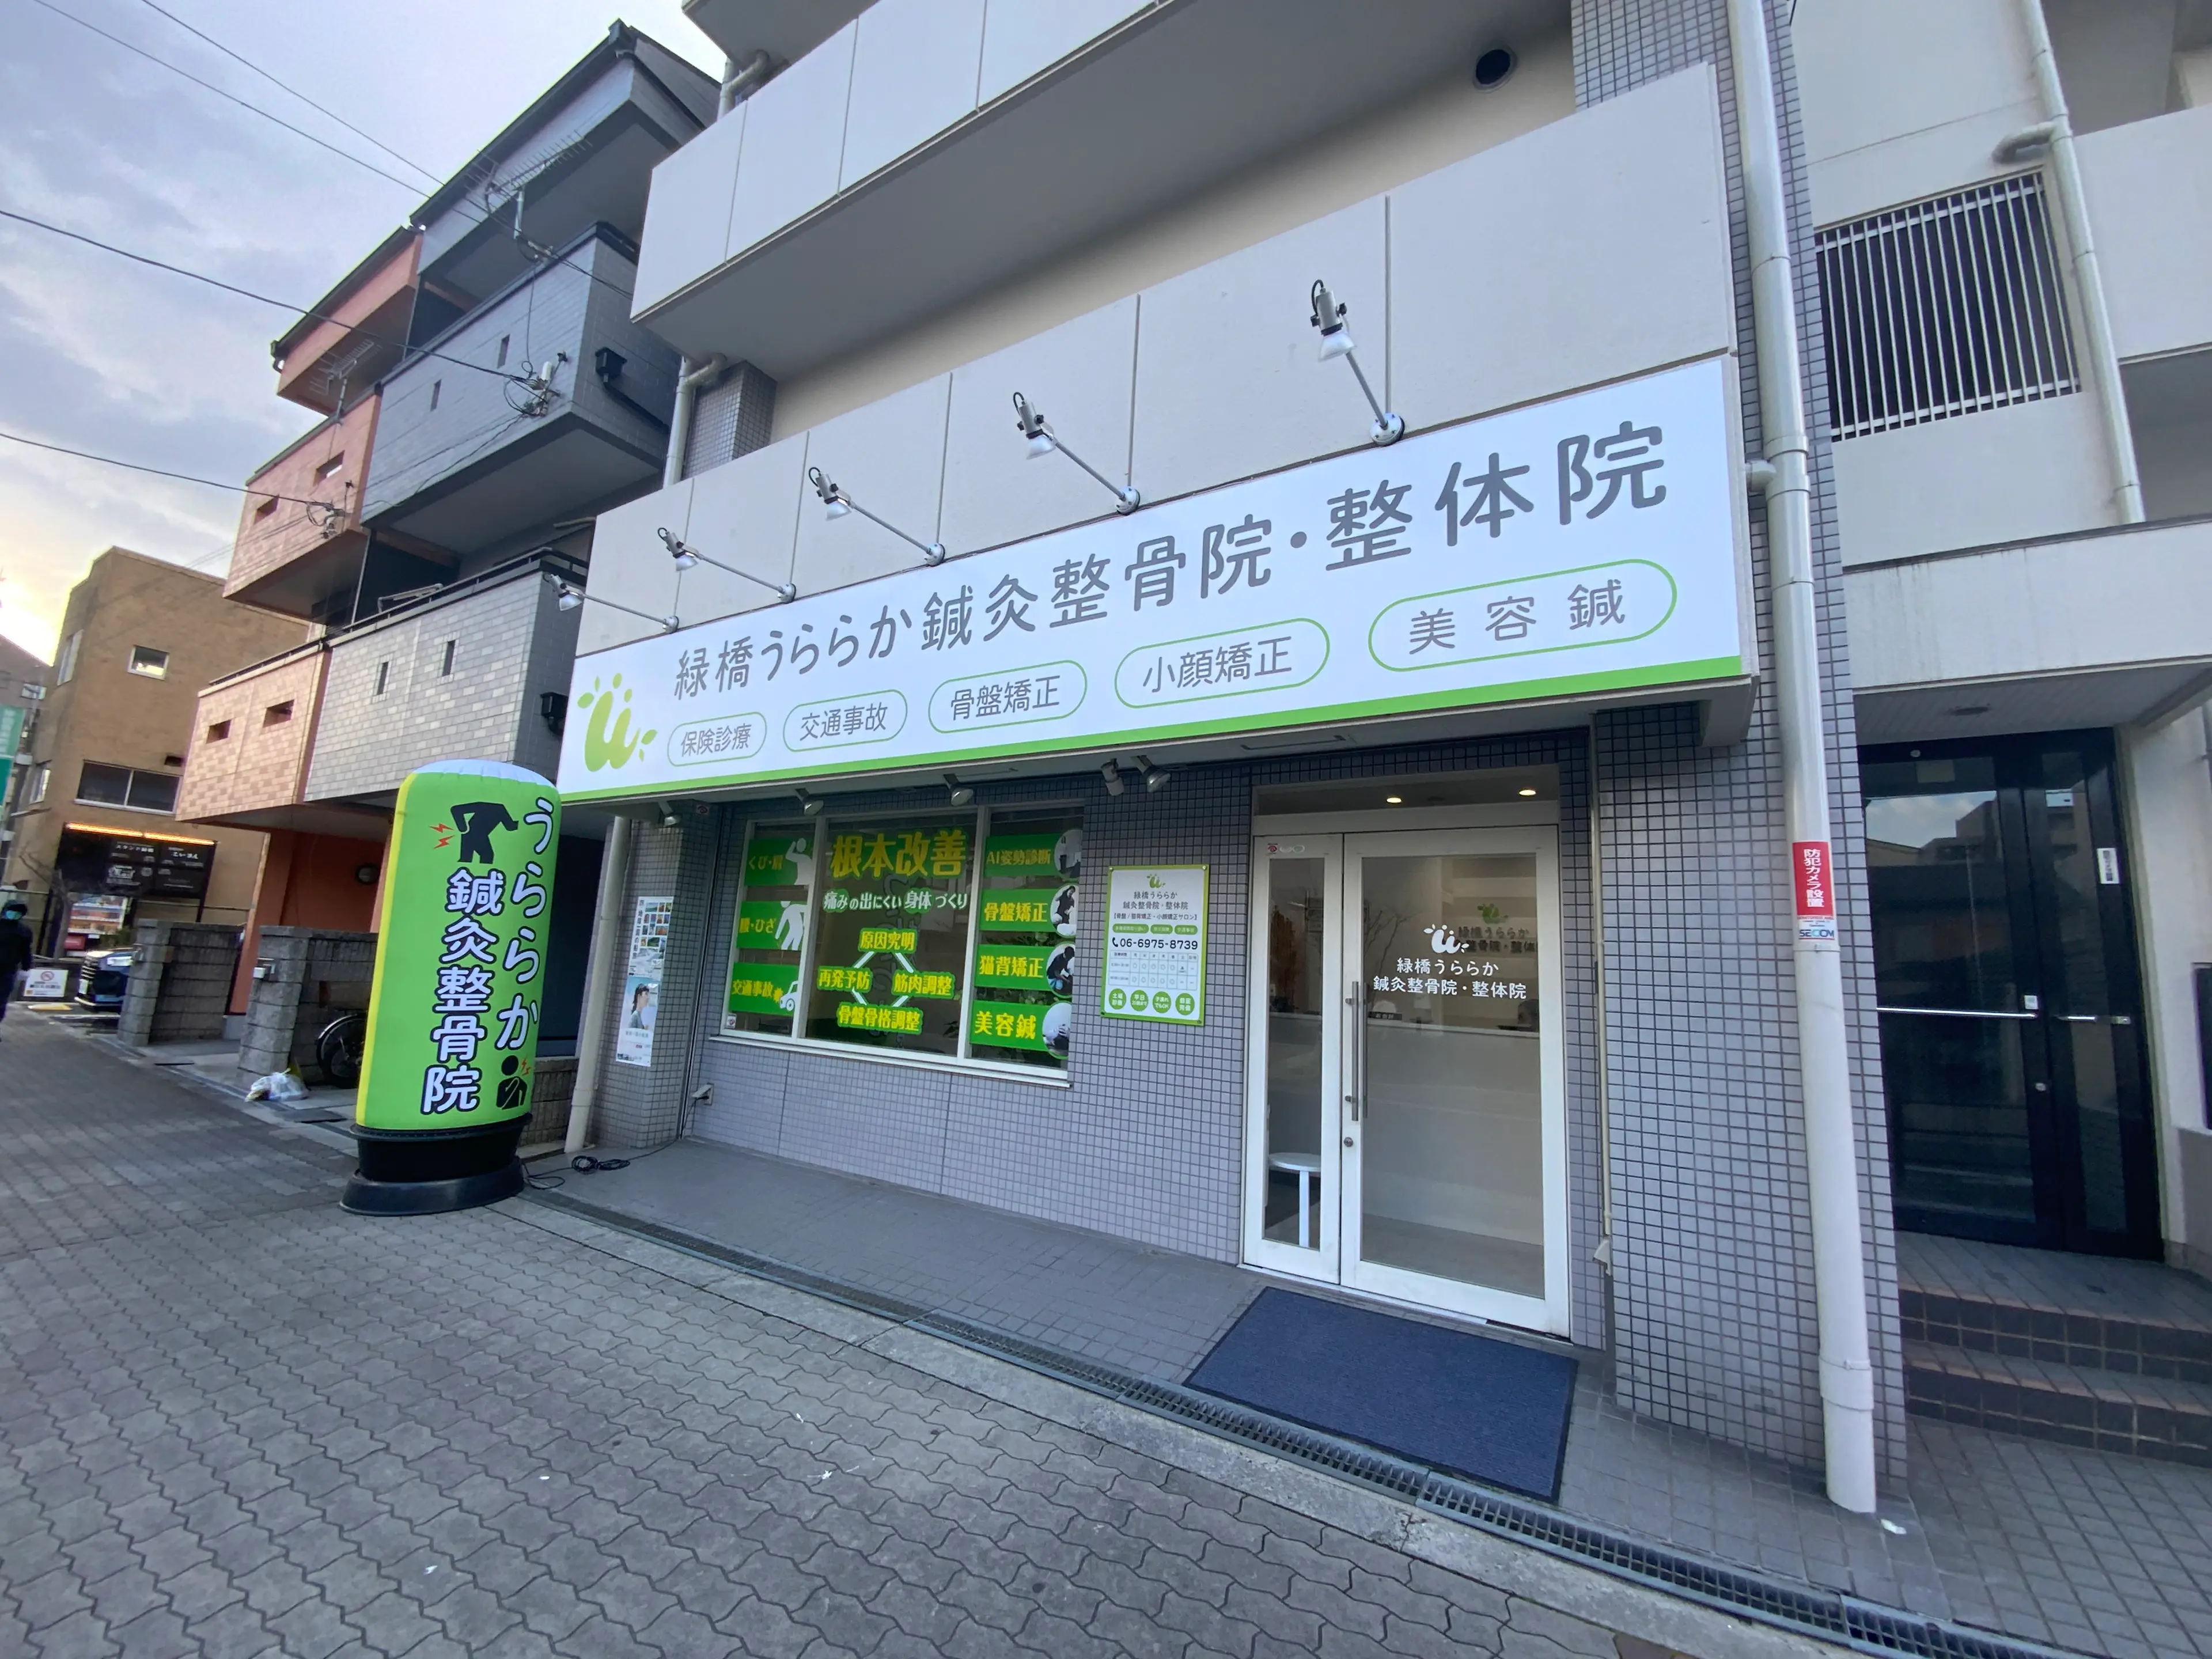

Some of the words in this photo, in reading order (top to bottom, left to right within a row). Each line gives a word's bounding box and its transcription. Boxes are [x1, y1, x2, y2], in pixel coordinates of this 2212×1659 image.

[673, 421, 1667, 700] 緑橋うららか鍼灸整骨院・整体院
[1409, 578, 1626, 655] 美容鍼
[1142, 636, 1293, 694] 小顔矯正
[950, 675, 1060, 721] 骨盤矯正
[799, 702, 889, 741] 交通事故
[680, 723, 752, 757] 保険診療
[830, 830, 967, 878] 根本改善
[1804, 849, 1824, 908] 防犯カメラ設置
[823, 891, 967, 910] 痛みの出にくい身体づくり
[1134, 891, 1177, 899] 緑橋うららか
[495, 797, 555, 1051] うららか
[984, 902, 1048, 922] 骨盤矯正
[860, 931, 915, 950] 原因究明
[1120, 938, 1198, 950] 06-6975-8739
[1799, 929, 1835, 937] SECOM
[979, 955, 1044, 978] 猫背矯正
[1397, 957, 1499, 977] 緑橋うららか
[421, 867, 505, 1116] 鍼灸整骨院
[732, 979, 774, 998] 交通事故
[819, 969, 870, 990] 再発予防
[893, 973, 952, 996] 筋肉調整
[1373, 976, 1527, 999] 鍼灸整骨院・整体院
[839, 1005, 920, 1031] 骨盤骨格調整
[975, 1010, 1036, 1040] 美容鍼
